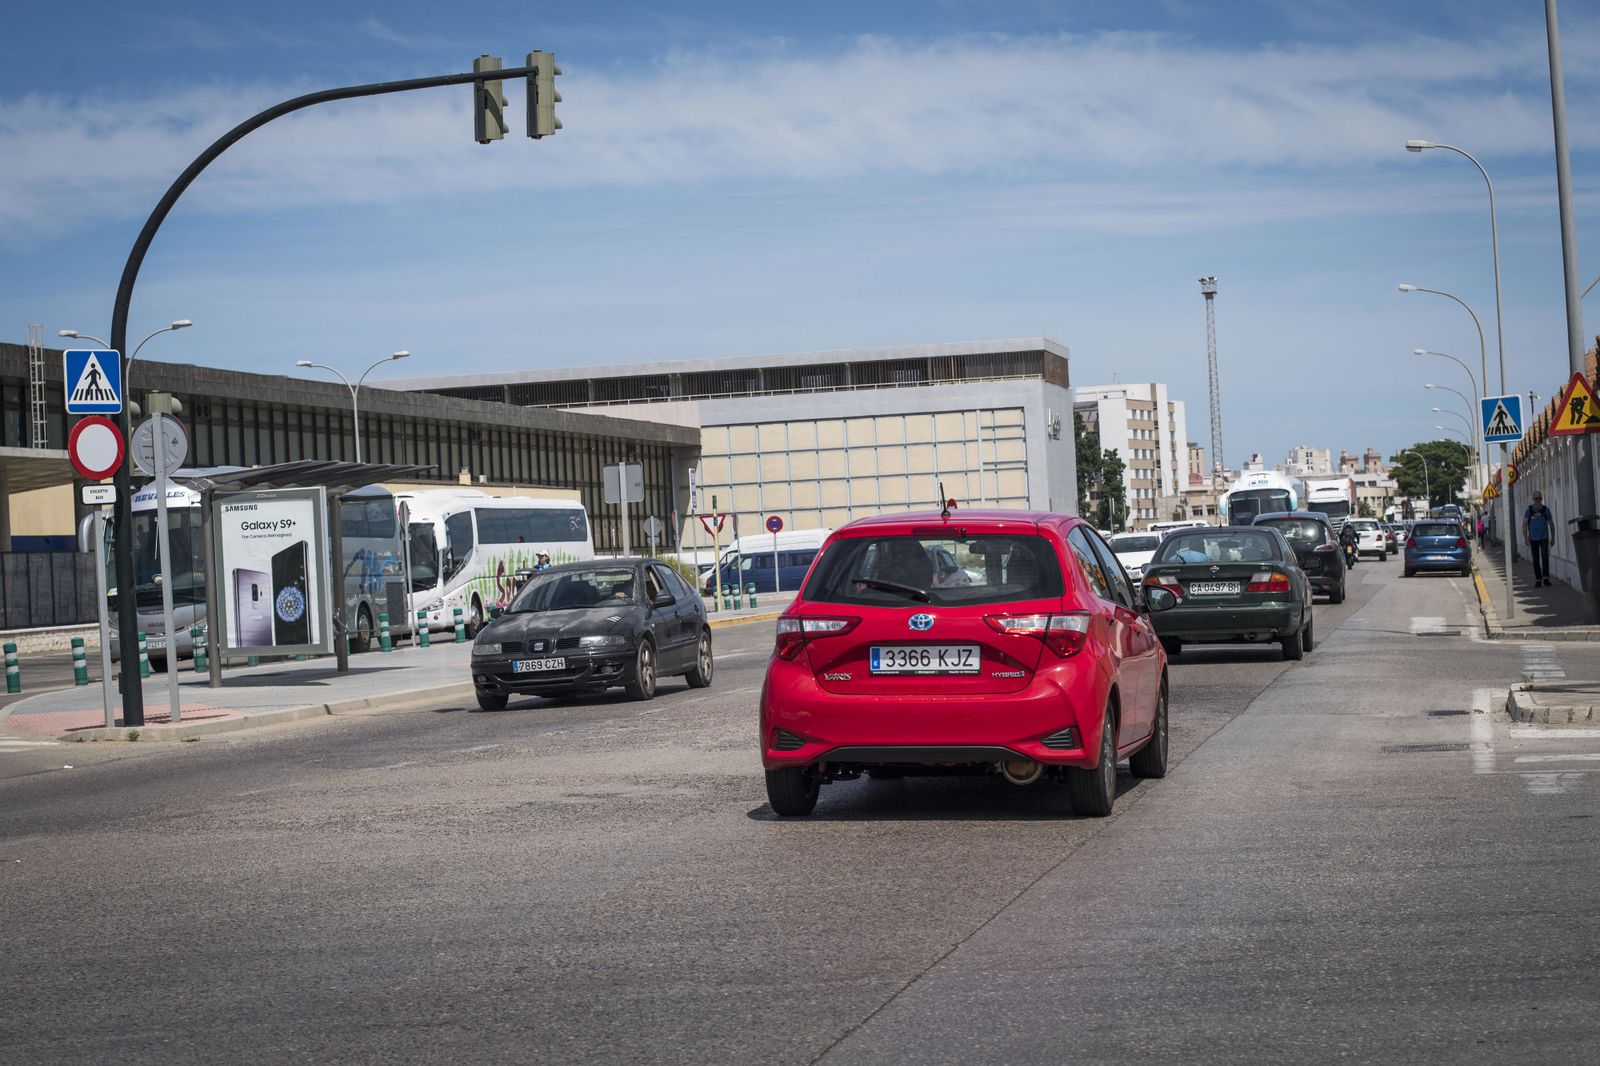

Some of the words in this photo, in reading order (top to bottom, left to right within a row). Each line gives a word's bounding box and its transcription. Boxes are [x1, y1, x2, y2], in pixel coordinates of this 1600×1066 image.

[224, 504, 258, 512] SAMSUNG
[241, 520, 278, 531] Galaxy
[280, 519, 296, 529] S9+
[886, 650, 931, 668] 3366
[938, 648, 973, 666] KJZ
[519, 660, 542, 671] 7869
[545, 658, 564, 669] CZH
